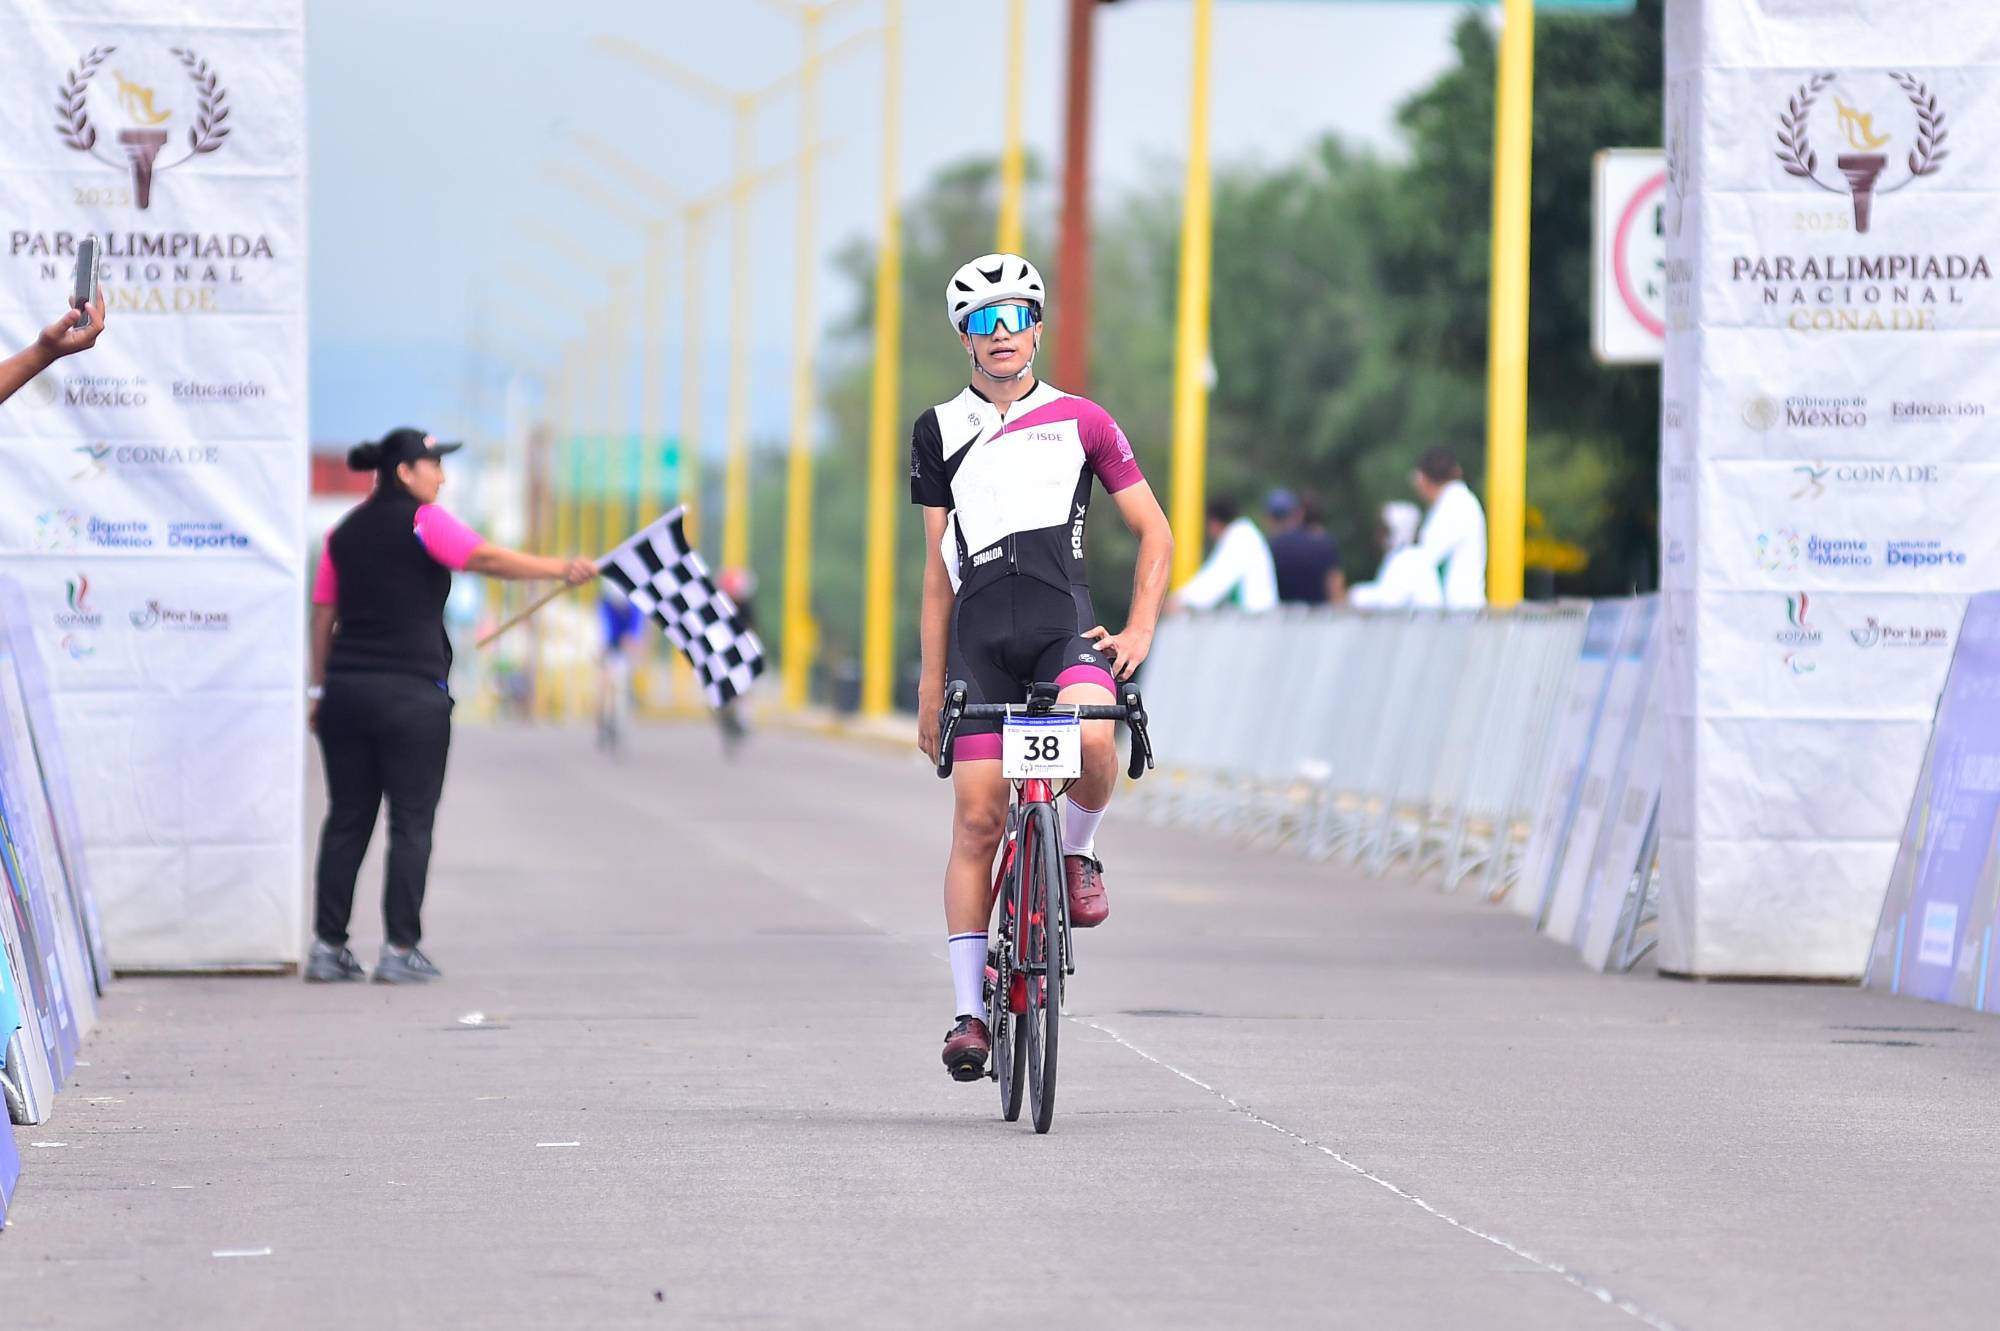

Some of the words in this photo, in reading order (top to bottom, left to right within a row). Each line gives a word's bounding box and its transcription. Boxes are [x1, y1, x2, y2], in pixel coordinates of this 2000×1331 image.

[9, 231, 273, 258] PARLIMPIADA
[41, 264, 243, 281] NCIONAL
[1732, 254, 1993, 281] PARALIMPIADA
[1763, 285, 1963, 304] NACIONAL
[1788, 308, 1936, 332] CONADE
[64, 387, 147, 407] México
[172, 380, 266, 398] Educación
[1785, 395, 1849, 407] Gobierno
[1852, 396, 1867, 406] de
[1892, 400, 1985, 417] Educación
[1786, 406, 1867, 427] México
[116, 446, 219, 464] CONADE
[1836, 464, 1938, 482] CONADE
[168, 531, 249, 550] Deporte
[1887, 549, 1967, 568] Deporte
[162, 609, 186, 622] Por
[1883, 625, 1906, 639] Por
[1024, 735, 1060, 761] 38
